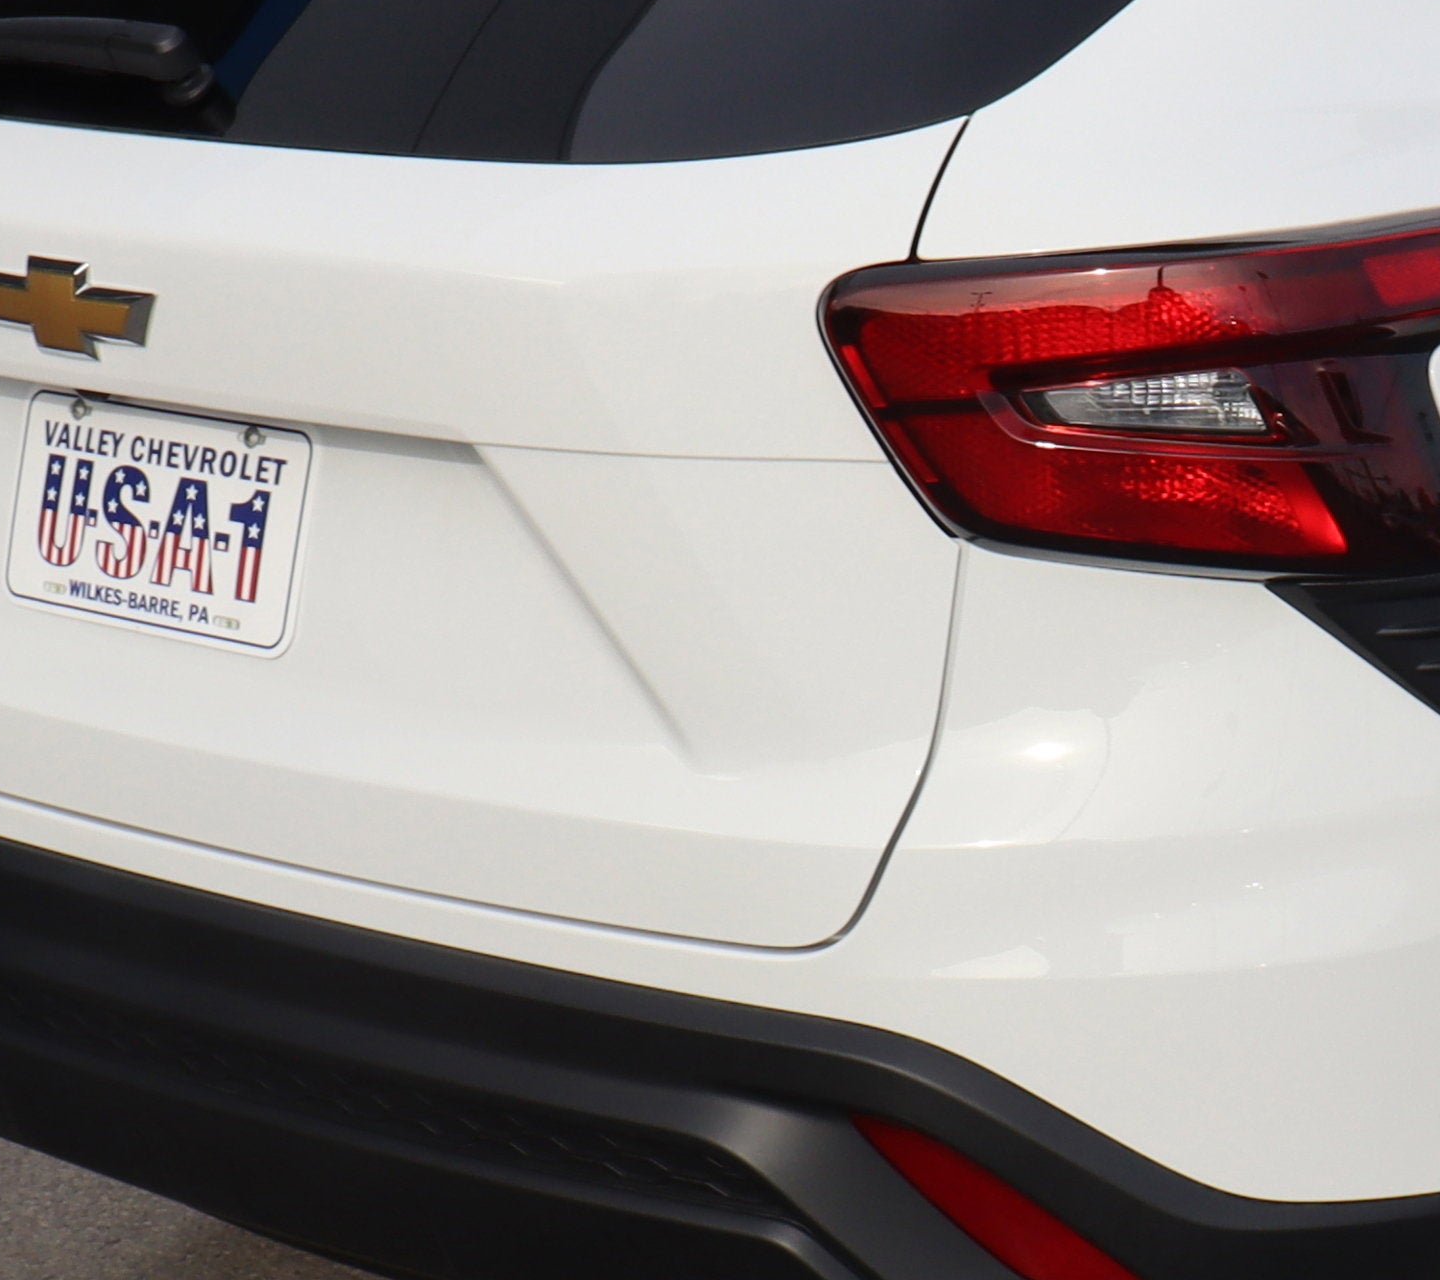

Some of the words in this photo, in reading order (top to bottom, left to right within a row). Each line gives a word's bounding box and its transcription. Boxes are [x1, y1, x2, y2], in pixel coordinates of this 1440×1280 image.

[44, 420, 125, 458] VALLEY
[129, 434, 288, 486] CHEVROLET
[68, 578, 183, 621] WILKES-BARRE,
[187, 603, 210, 625] PA
